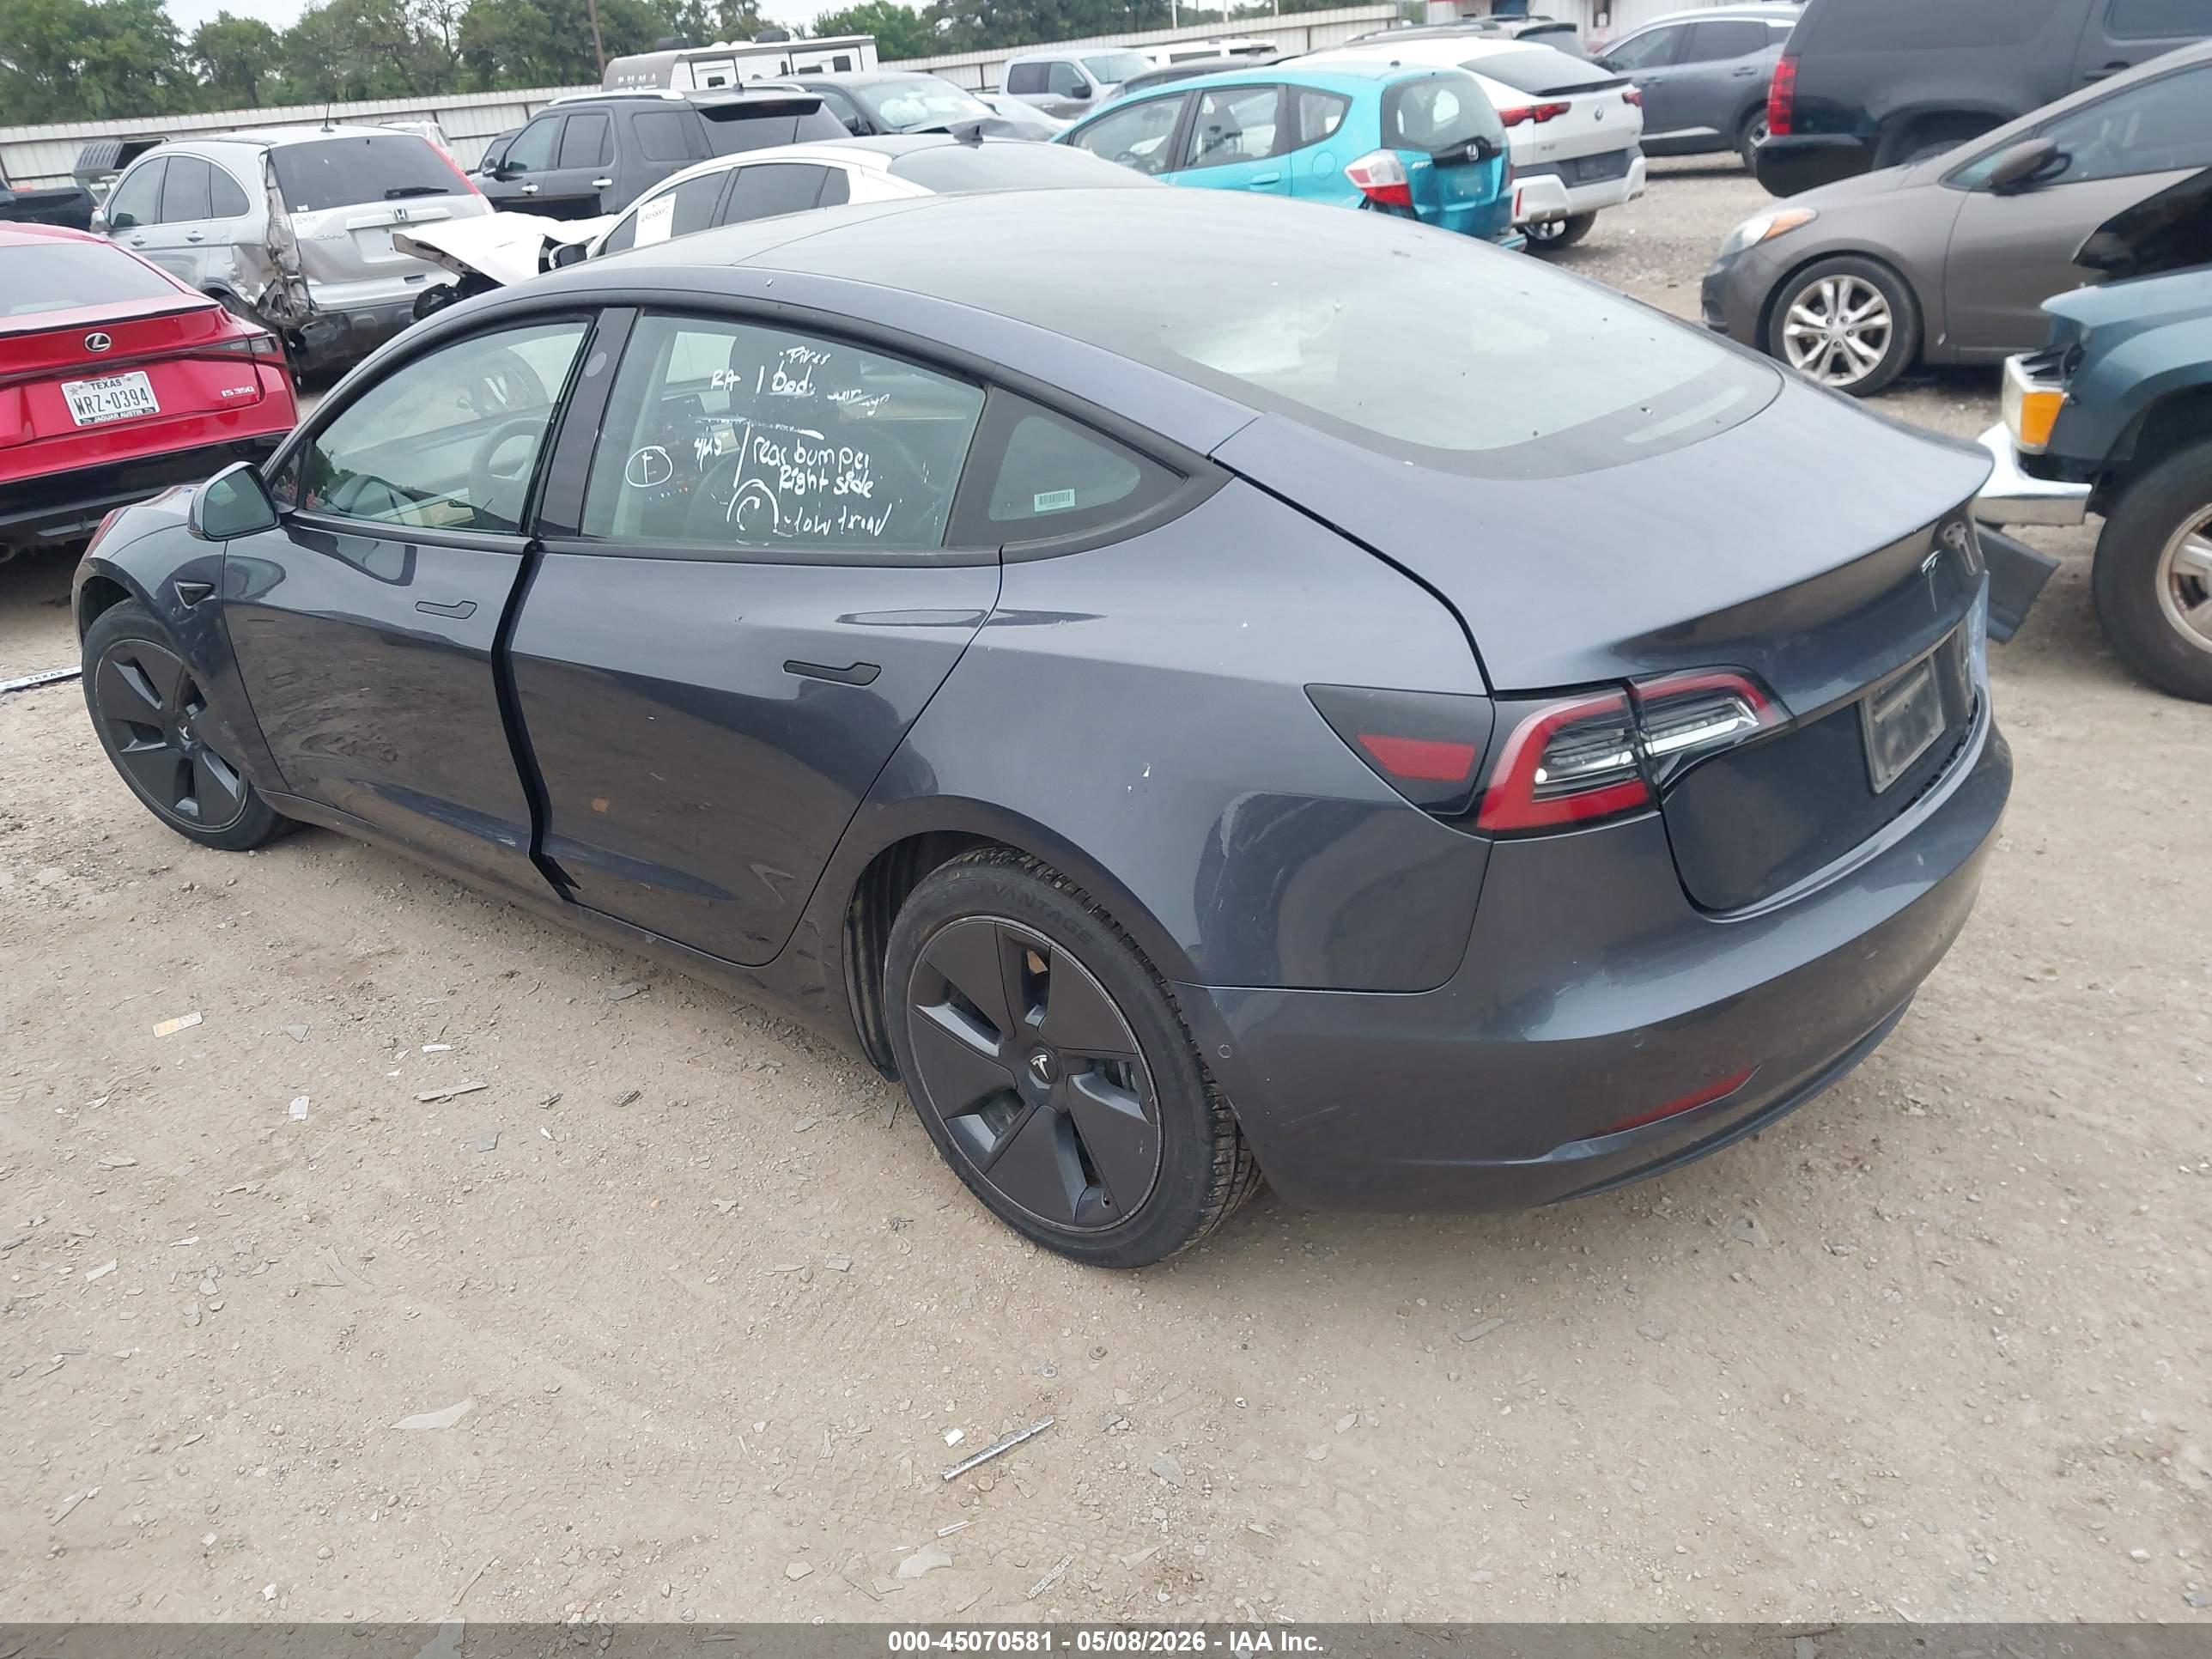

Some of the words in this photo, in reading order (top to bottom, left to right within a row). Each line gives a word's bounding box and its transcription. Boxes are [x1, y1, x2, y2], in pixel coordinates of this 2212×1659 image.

[90, 379, 122, 391] TEXAS
[94, 412, 119, 422] JAGUAR
[779, 465, 830, 495] Right
